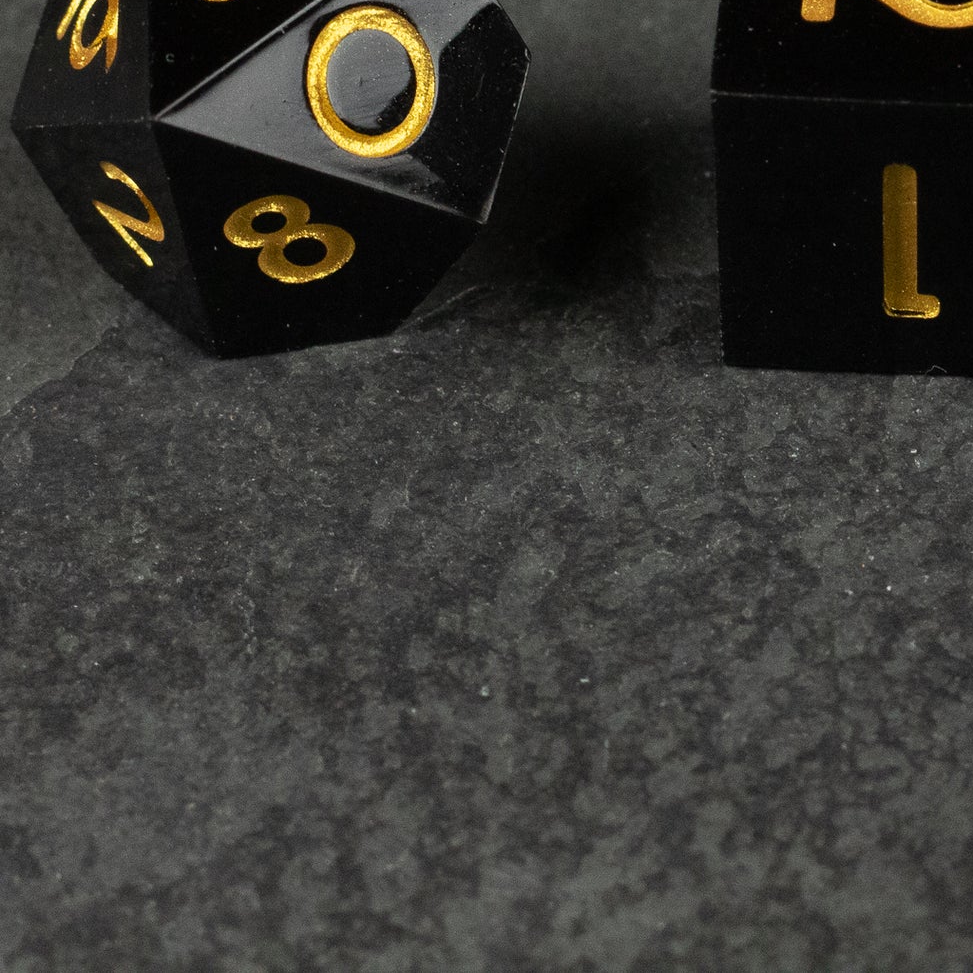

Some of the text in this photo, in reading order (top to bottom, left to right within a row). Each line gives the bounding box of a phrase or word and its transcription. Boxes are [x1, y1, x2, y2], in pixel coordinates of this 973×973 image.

[305, 4, 437, 159] 0
[92, 161, 166, 268] 2
[223, 194, 356, 285] 8
[882, 164, 942, 320] 1
